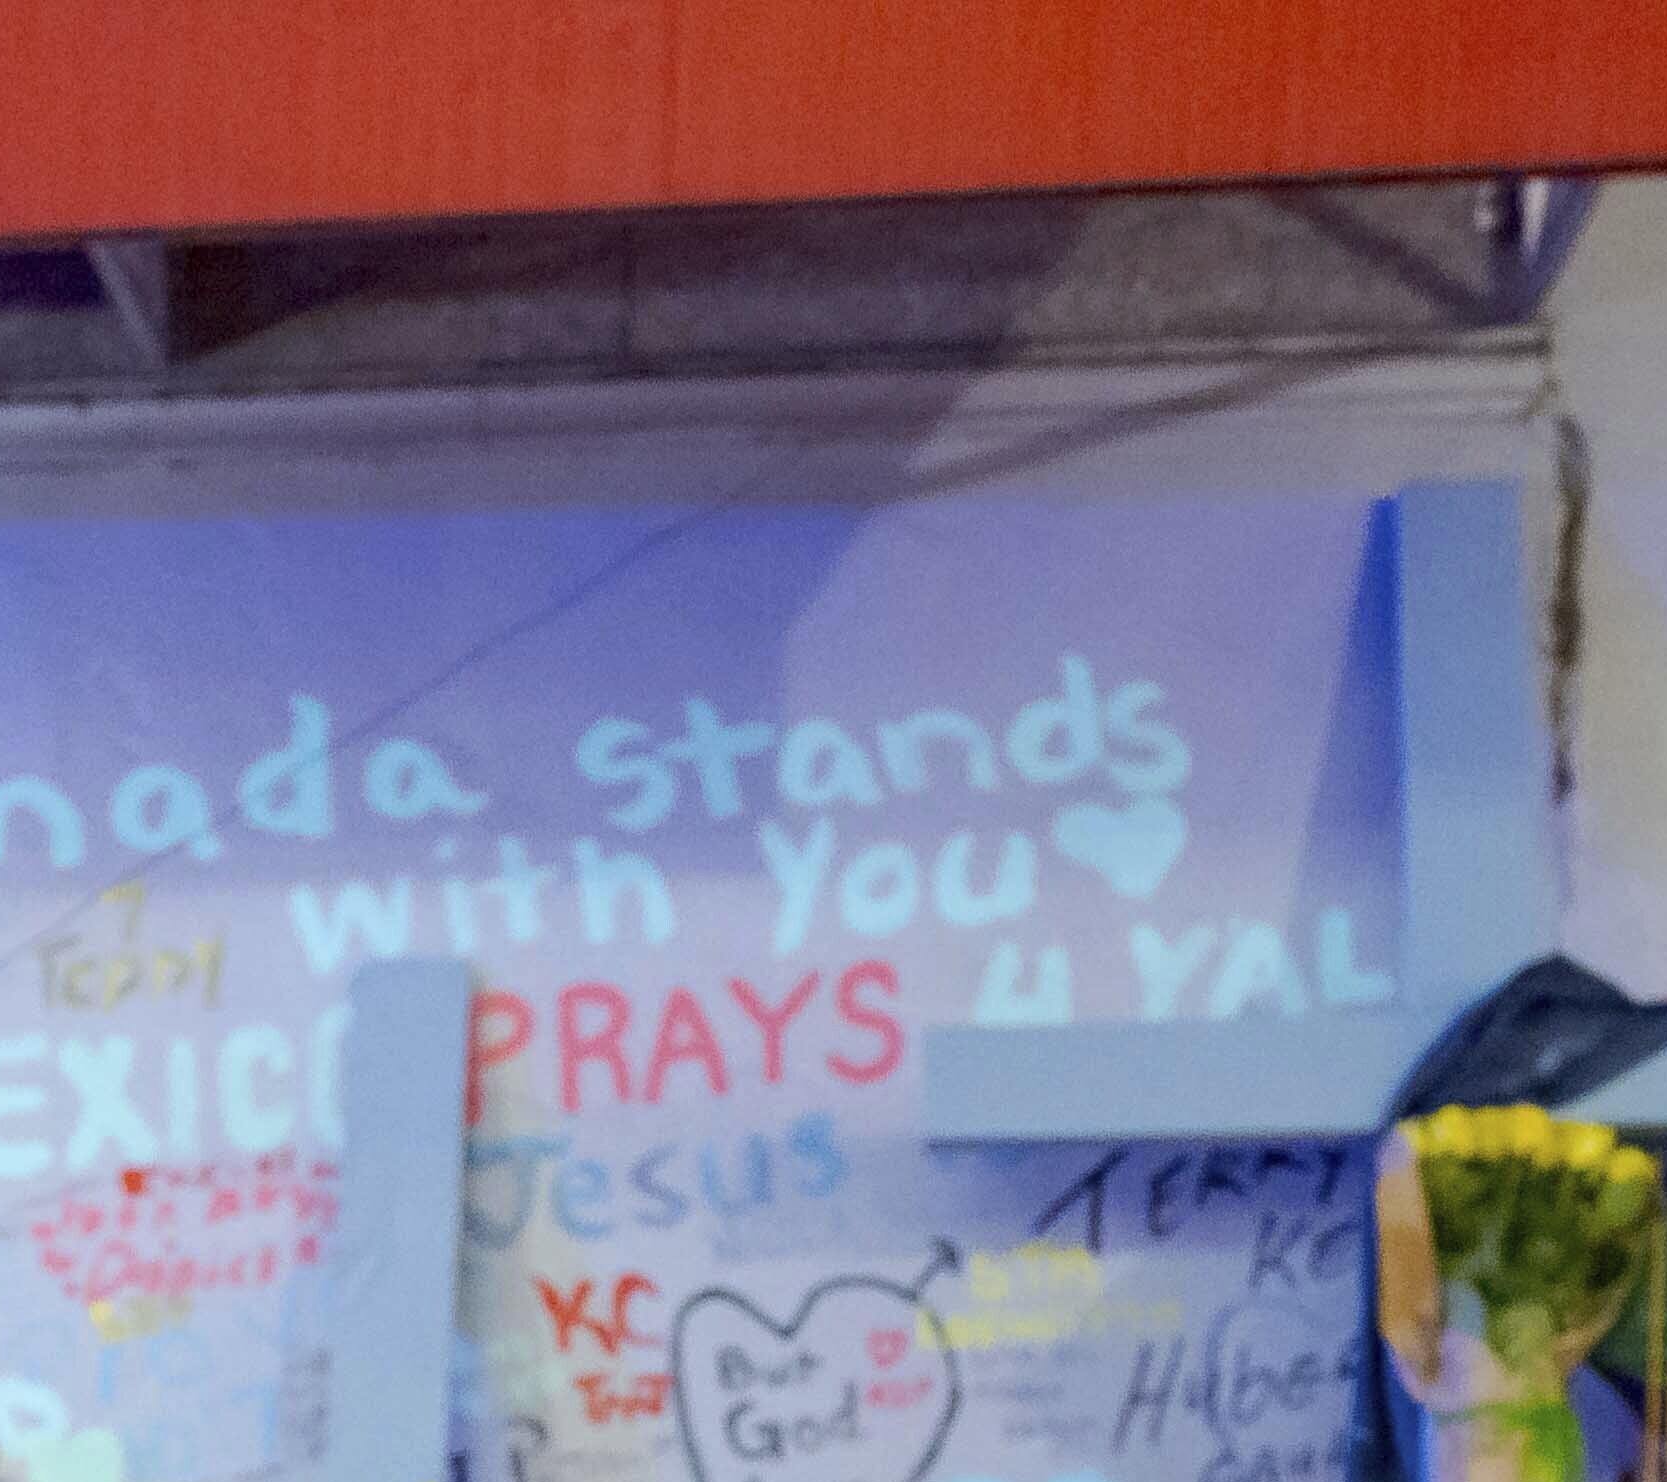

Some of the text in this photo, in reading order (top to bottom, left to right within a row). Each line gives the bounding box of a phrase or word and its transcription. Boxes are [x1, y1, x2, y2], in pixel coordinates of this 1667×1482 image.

[574, 650, 1192, 832] stands
[288, 832, 674, 976] with
[464, 958, 906, 1126] PRAYS
